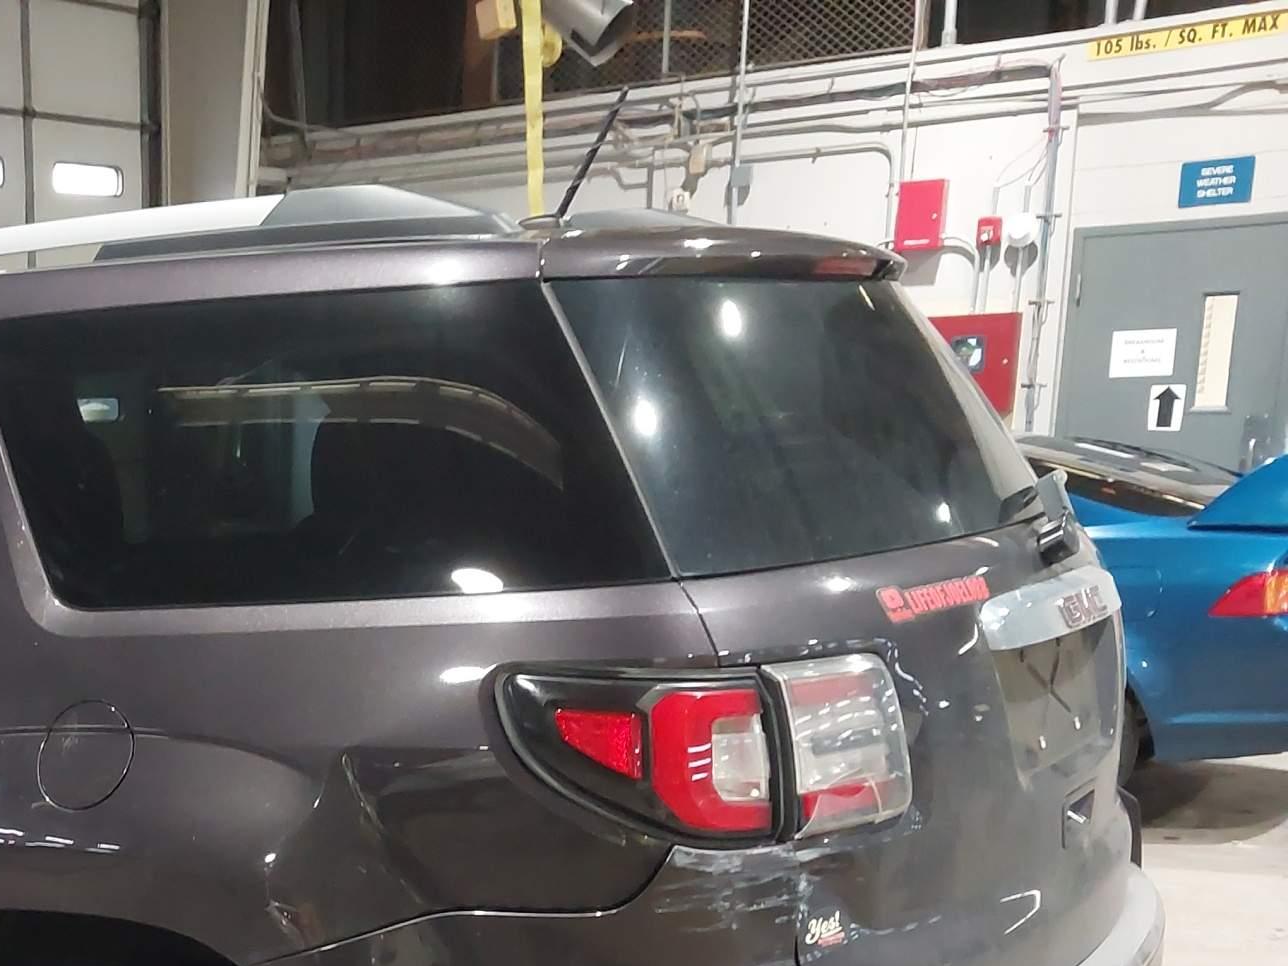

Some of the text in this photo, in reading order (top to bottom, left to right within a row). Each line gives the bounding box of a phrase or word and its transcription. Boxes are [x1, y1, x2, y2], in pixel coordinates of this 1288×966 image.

[1096, 40, 1123, 56] 105
[1130, 36, 1156, 52] lbs.
[1178, 28, 1203, 44] SQ.
[1211, 23, 1233, 39] FT.
[1242, 15, 1280, 35] MAX
[805, 910, 840, 945] Yes!
